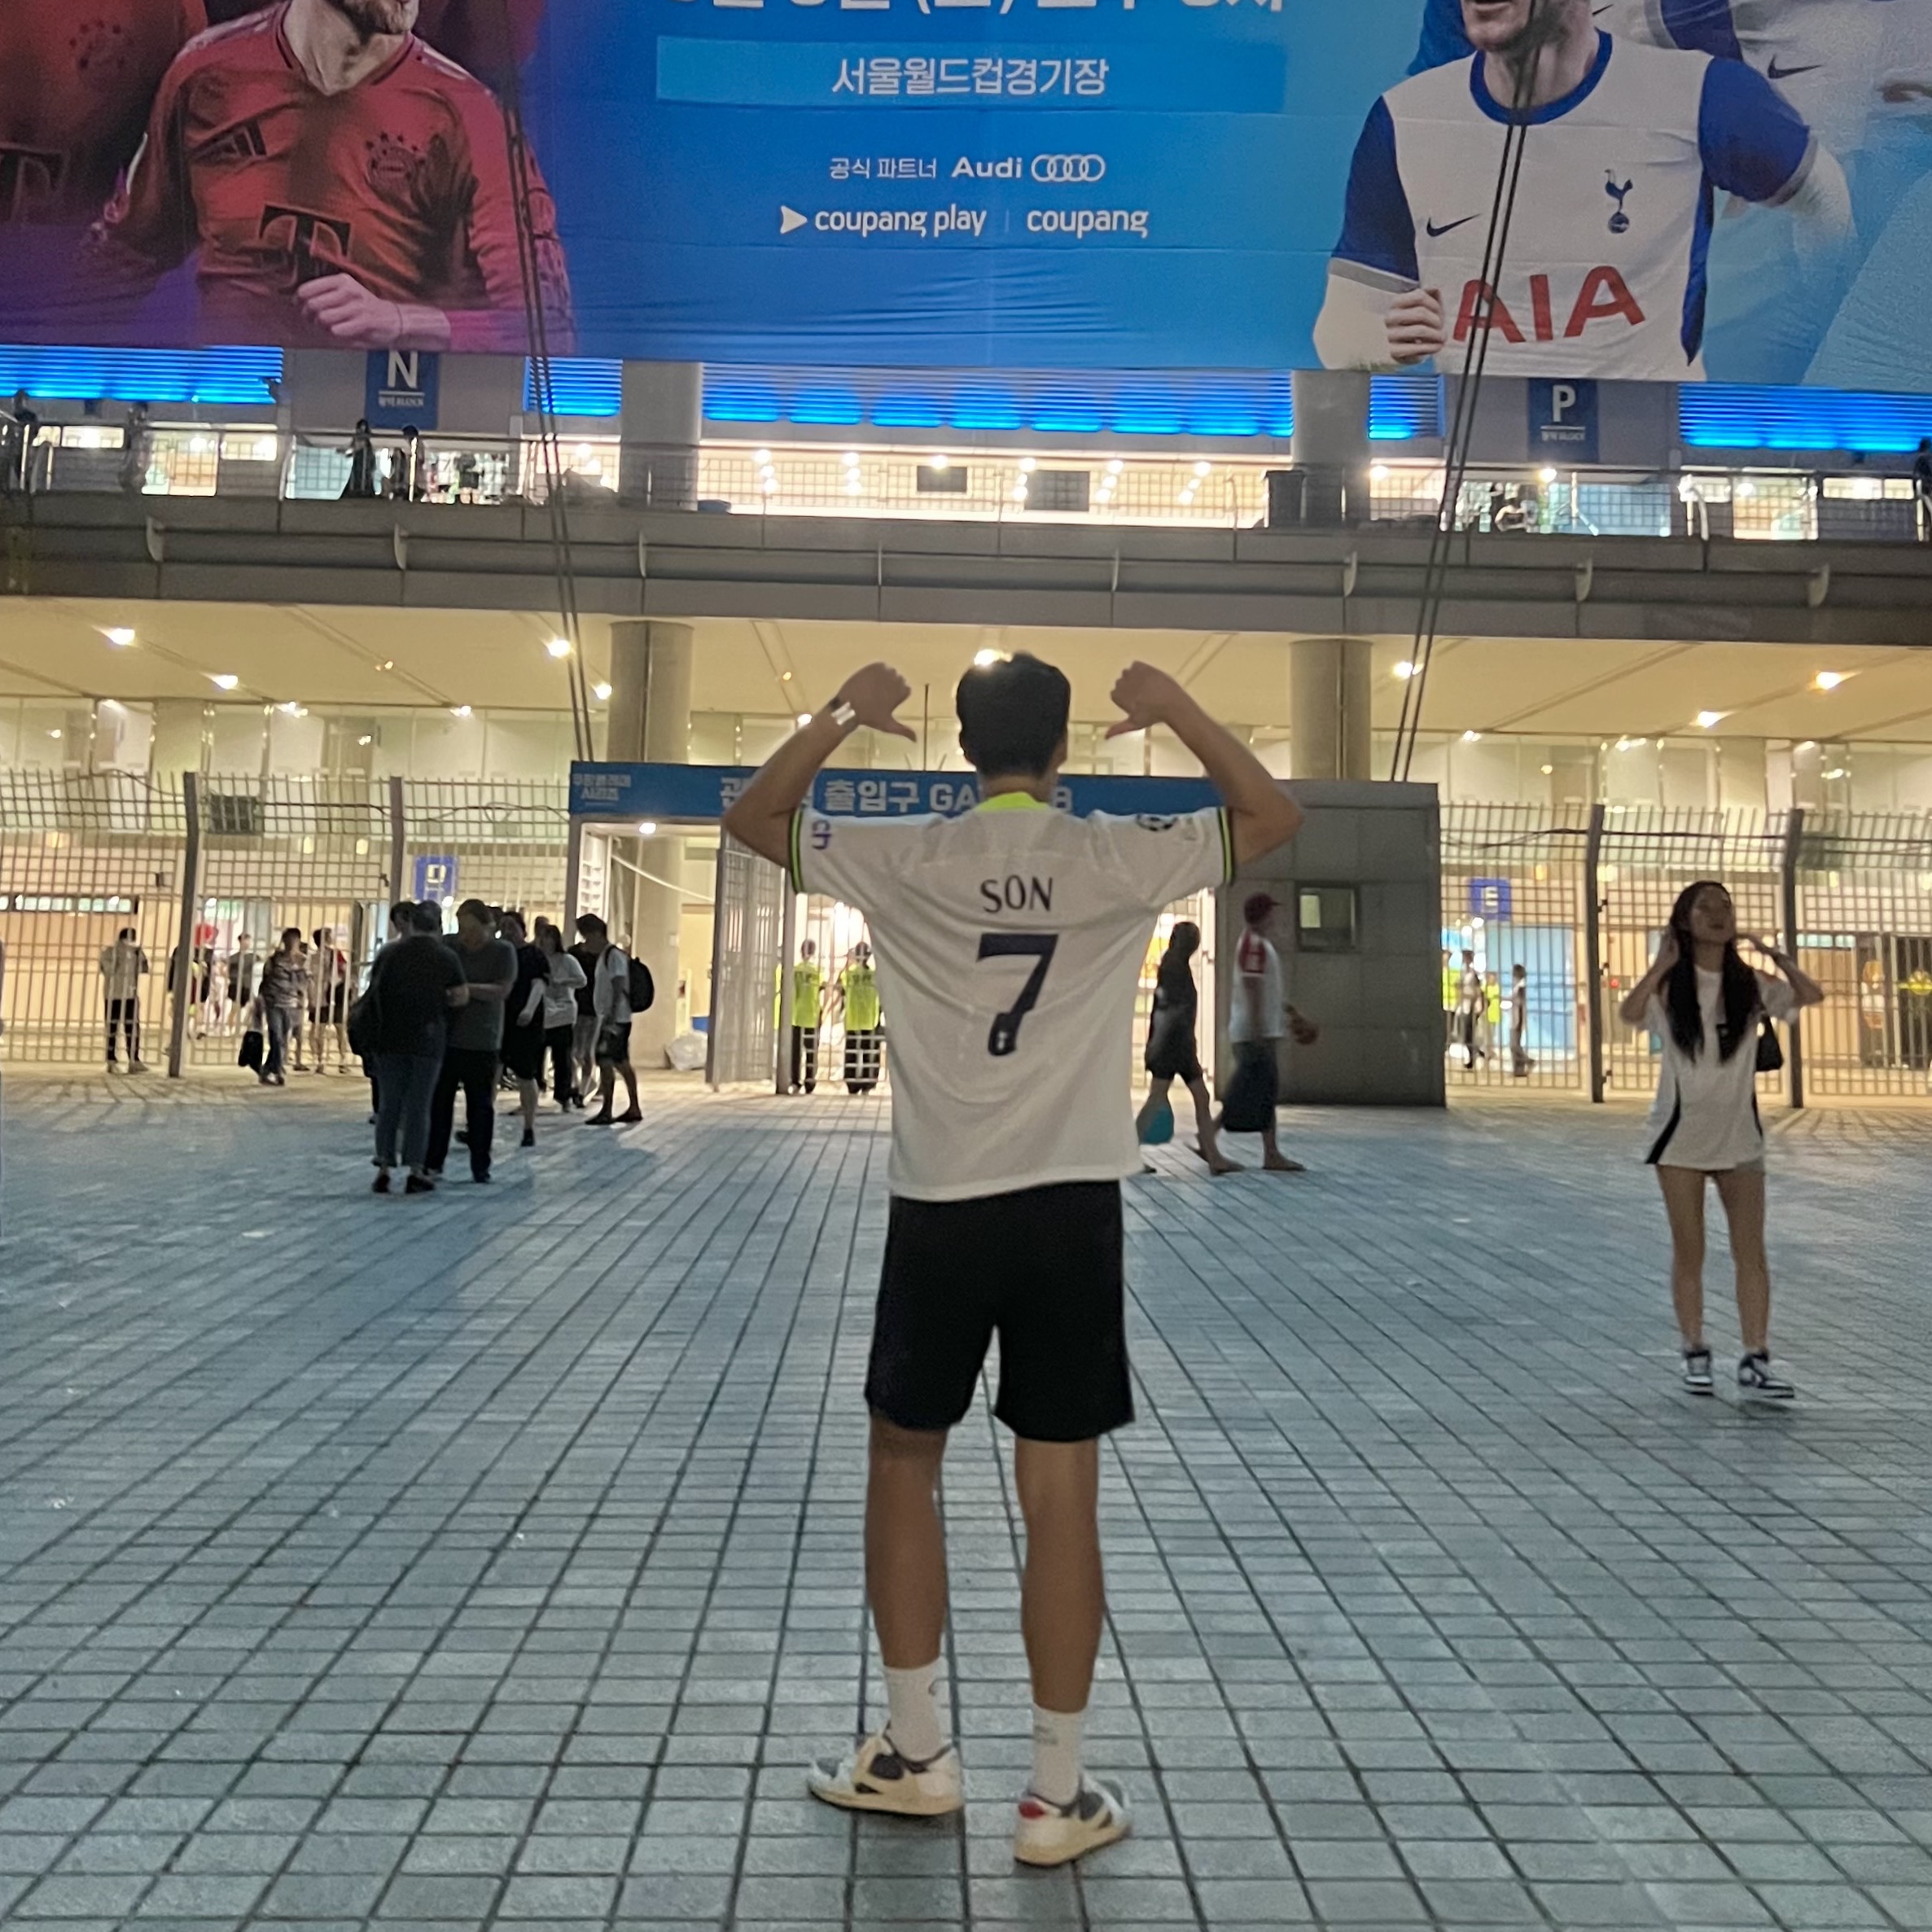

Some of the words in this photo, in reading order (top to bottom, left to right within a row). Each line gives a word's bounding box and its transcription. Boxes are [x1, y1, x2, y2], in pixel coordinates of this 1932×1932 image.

[831, 57, 1110, 95] 서울월드컵경기장
[829, 156, 871, 179] 공식
[877, 156, 937, 179] 파트너
[951, 156, 1023, 178] Audi
[814, 210, 926, 237] coupang
[934, 204, 987, 237] play
[1027, 209, 1149, 239] coupang
[1453, 265, 1646, 343] AIA
[388, 350, 418, 388] N
[1552, 384, 1576, 423] P
[824, 778, 920, 813] 출입구
[979, 874, 1054, 913] SON
[976, 932, 1059, 1057] 7
